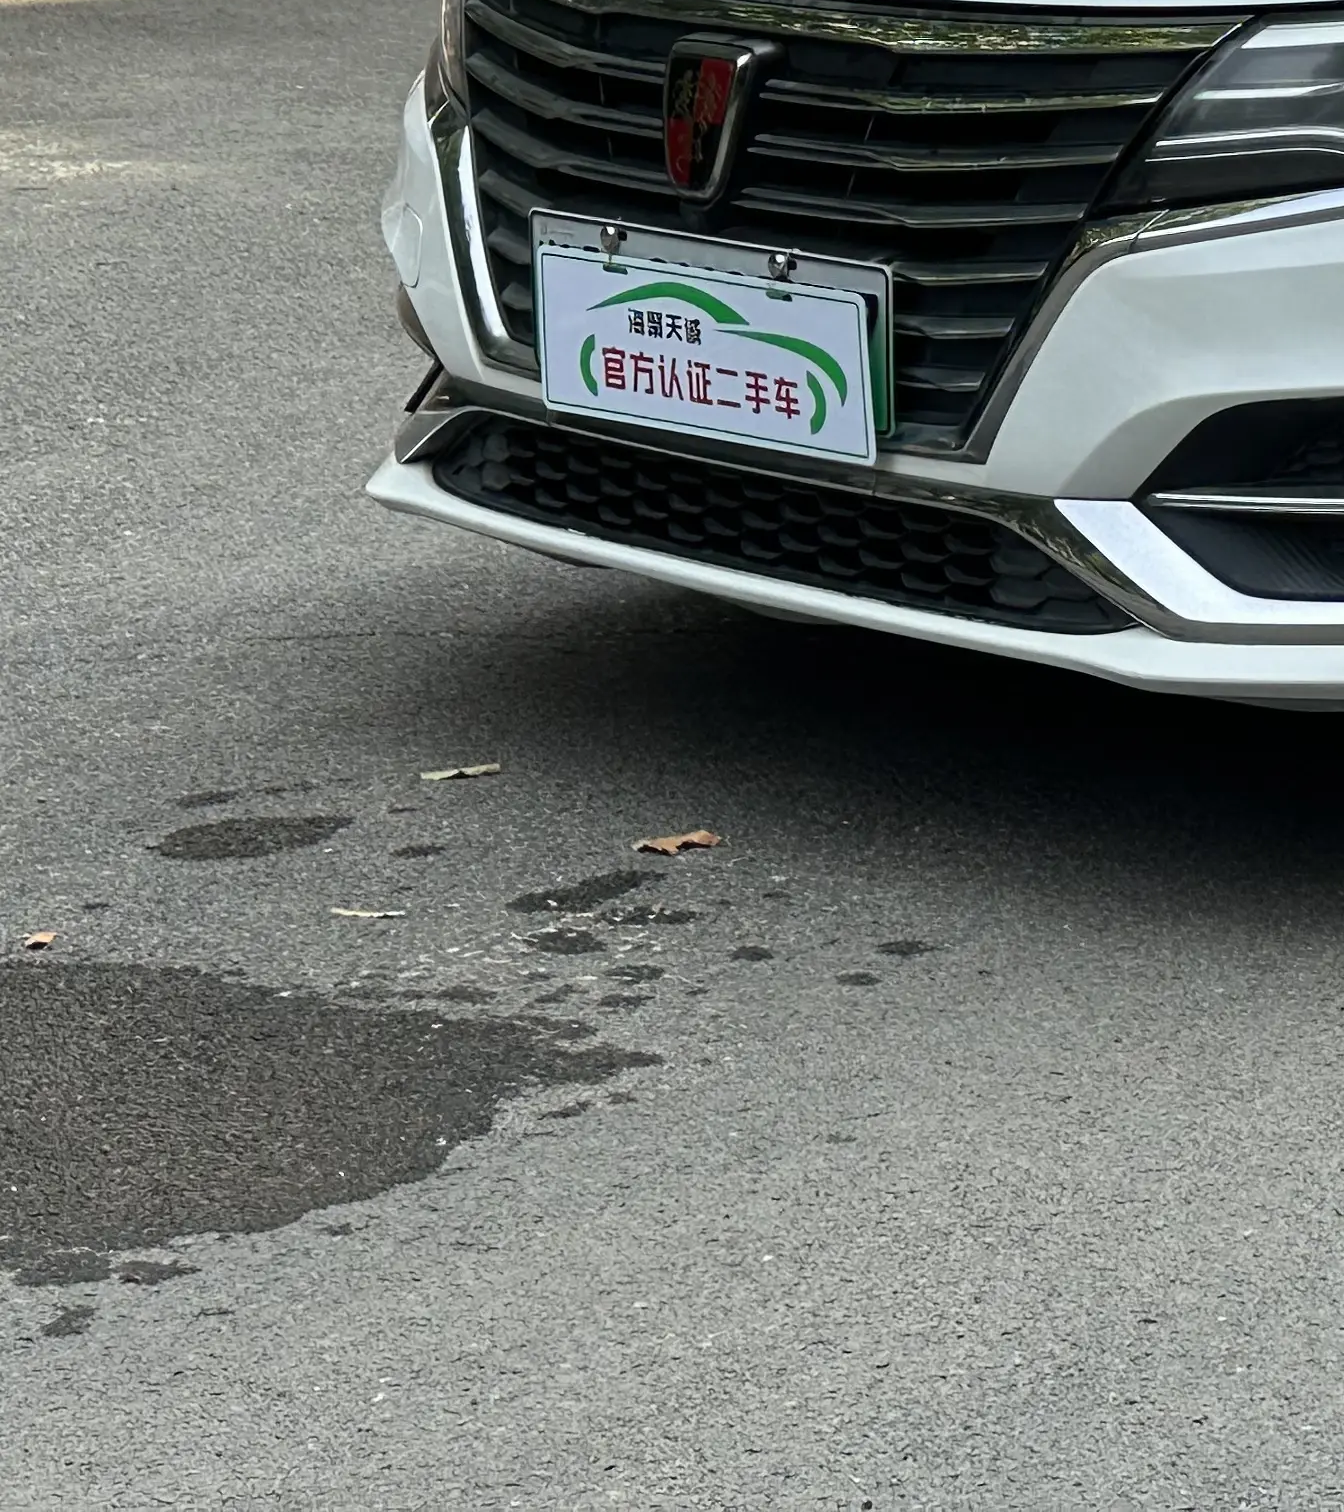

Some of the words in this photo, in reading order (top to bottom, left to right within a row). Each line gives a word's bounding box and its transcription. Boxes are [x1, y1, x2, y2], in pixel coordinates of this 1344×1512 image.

[602, 346, 801, 419] 官方认证二手车
